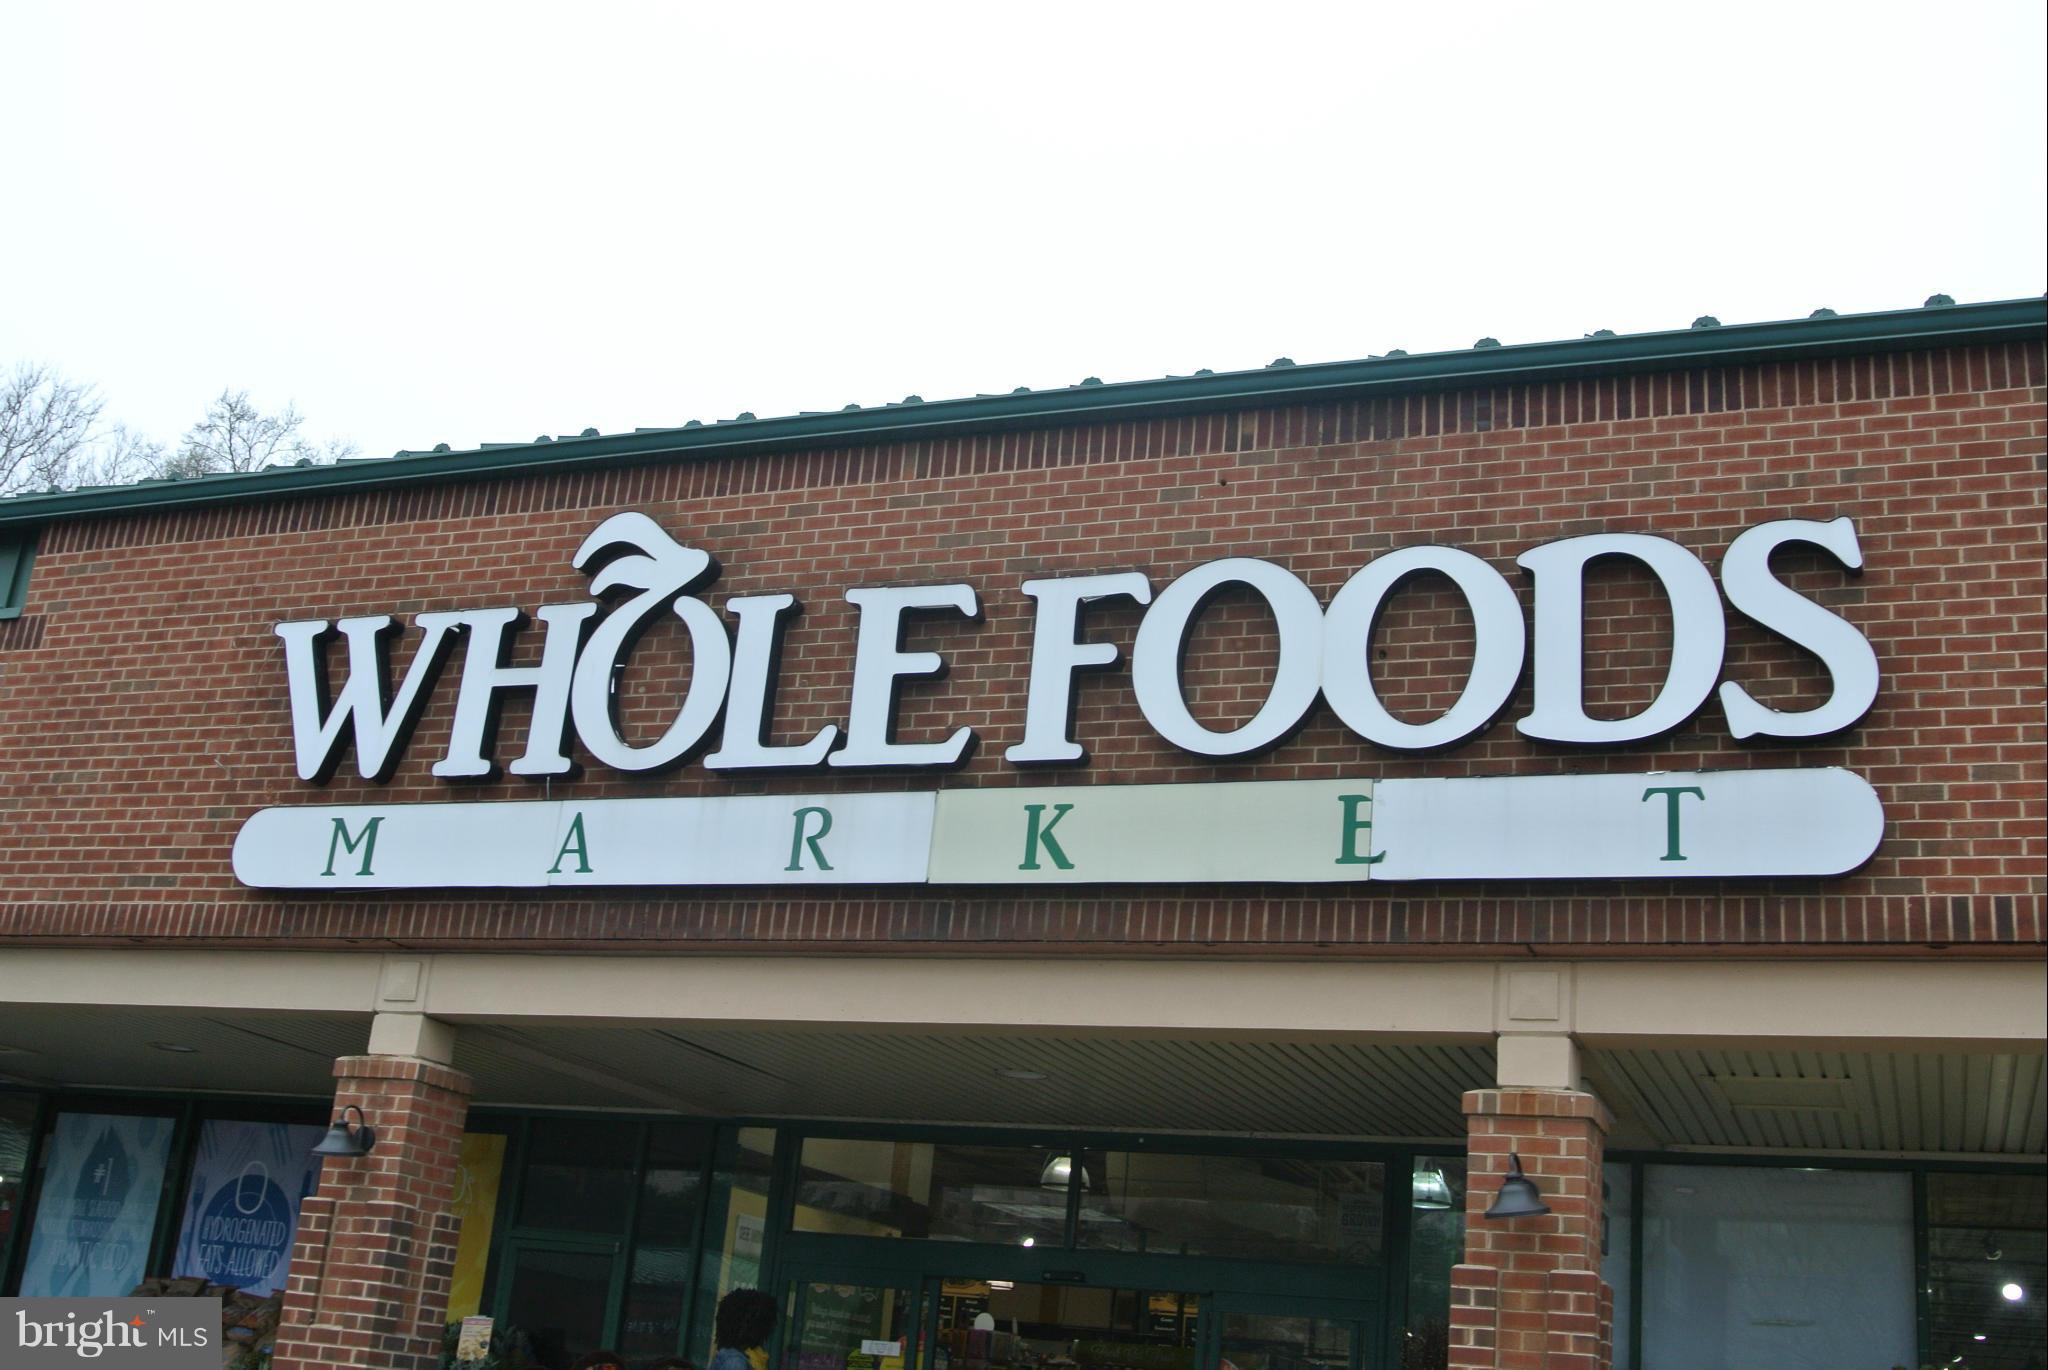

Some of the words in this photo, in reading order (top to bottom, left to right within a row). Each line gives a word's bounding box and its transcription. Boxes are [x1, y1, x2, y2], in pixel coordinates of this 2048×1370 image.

[275, 512, 977, 780] WHOLE
[1005, 516, 1880, 765] FOODS
[320, 786, 1706, 878] MARKET
[199, 1244, 225, 1274] FATS
[226, 1246, 279, 1278] ALLOWED
[202, 1216, 286, 1246] HYDROGENATED
